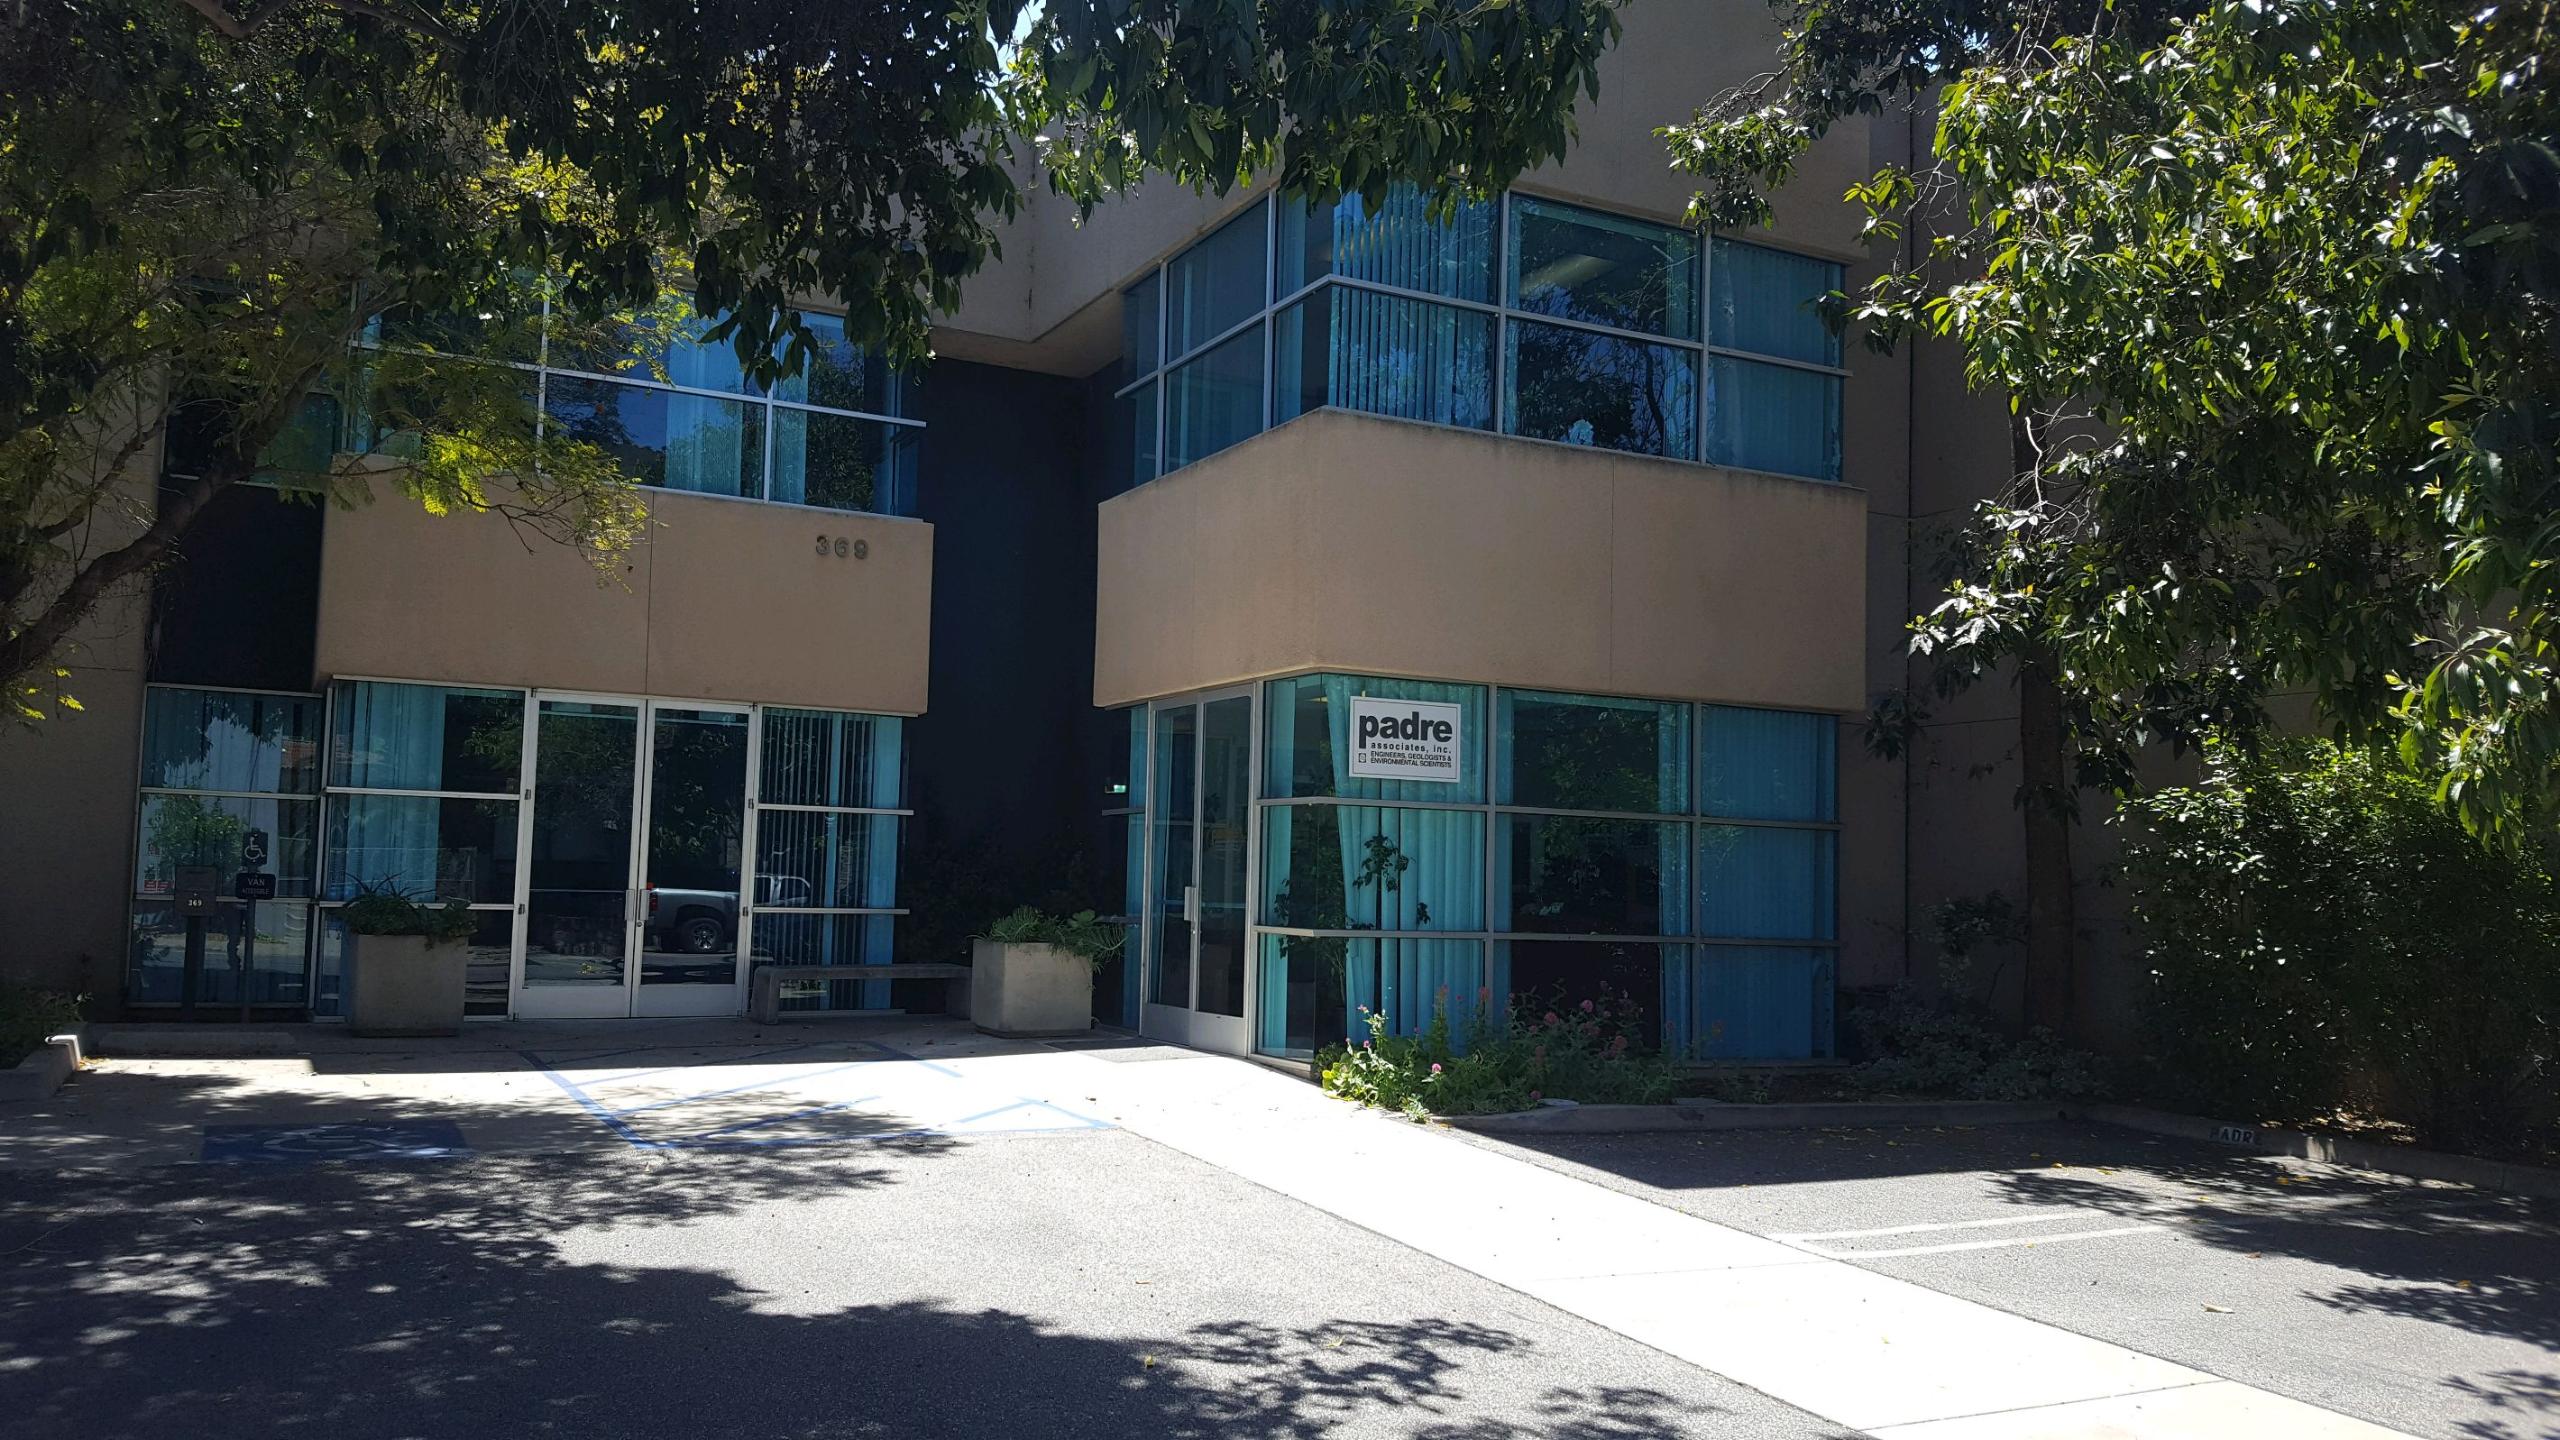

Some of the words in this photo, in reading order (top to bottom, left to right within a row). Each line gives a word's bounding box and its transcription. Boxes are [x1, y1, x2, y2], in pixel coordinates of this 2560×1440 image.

[815, 535, 869, 560] 369
[1358, 711, 1452, 749] padre
[1370, 742, 1429, 753] associates,
[1433, 745, 1452, 754] inc.
[1371, 758, 1419, 766] ENVIRONMENTAL
[1408, 753, 1446, 761] GEOLOGISTS
[247, 878, 265, 887] VAN
[188, 899, 202, 907] 369
[2209, 1128, 2262, 1145] PADR
